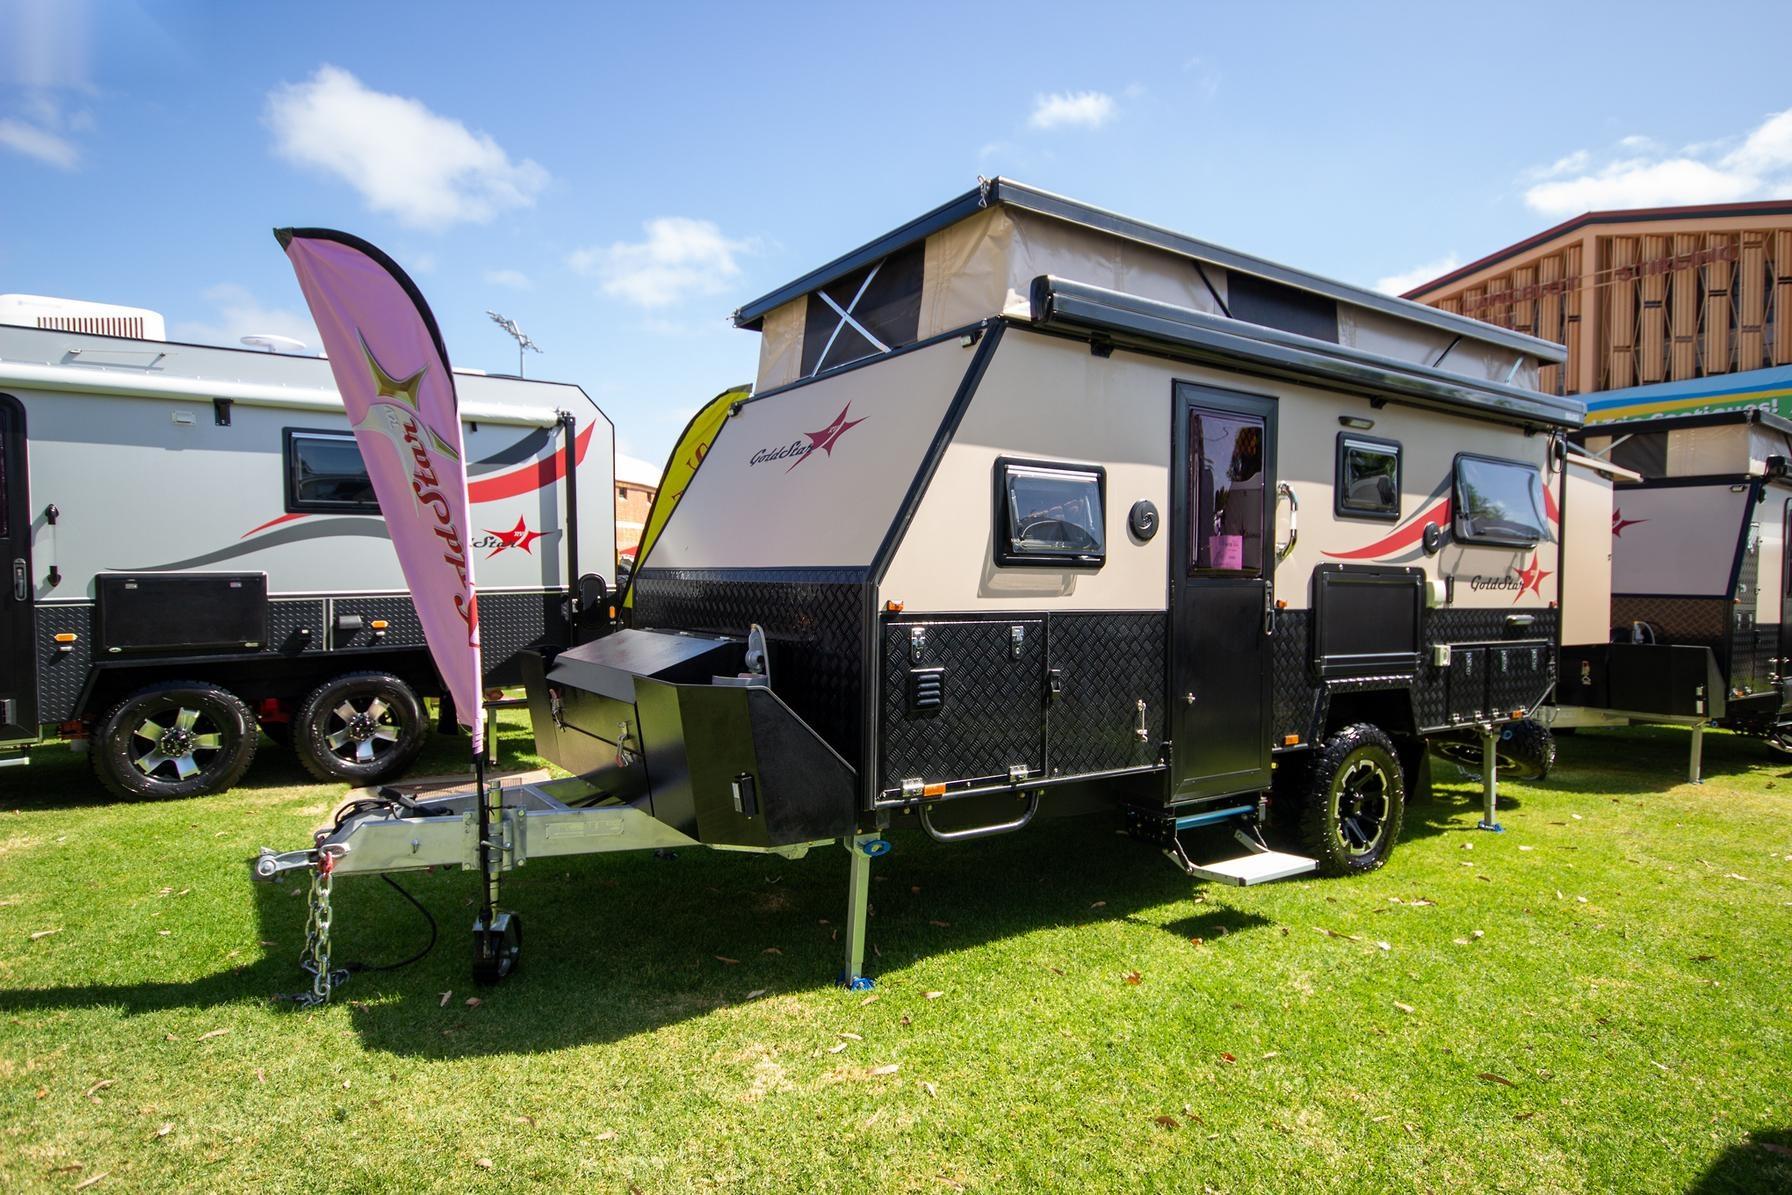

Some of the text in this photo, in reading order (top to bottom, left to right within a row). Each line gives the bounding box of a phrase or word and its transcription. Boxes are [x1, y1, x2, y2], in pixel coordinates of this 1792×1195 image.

[749, 440, 814, 467] GoldStar
[403, 416, 480, 648] GldStar
[471, 535, 518, 549] Star
[1470, 574, 1524, 592] GoldStar
